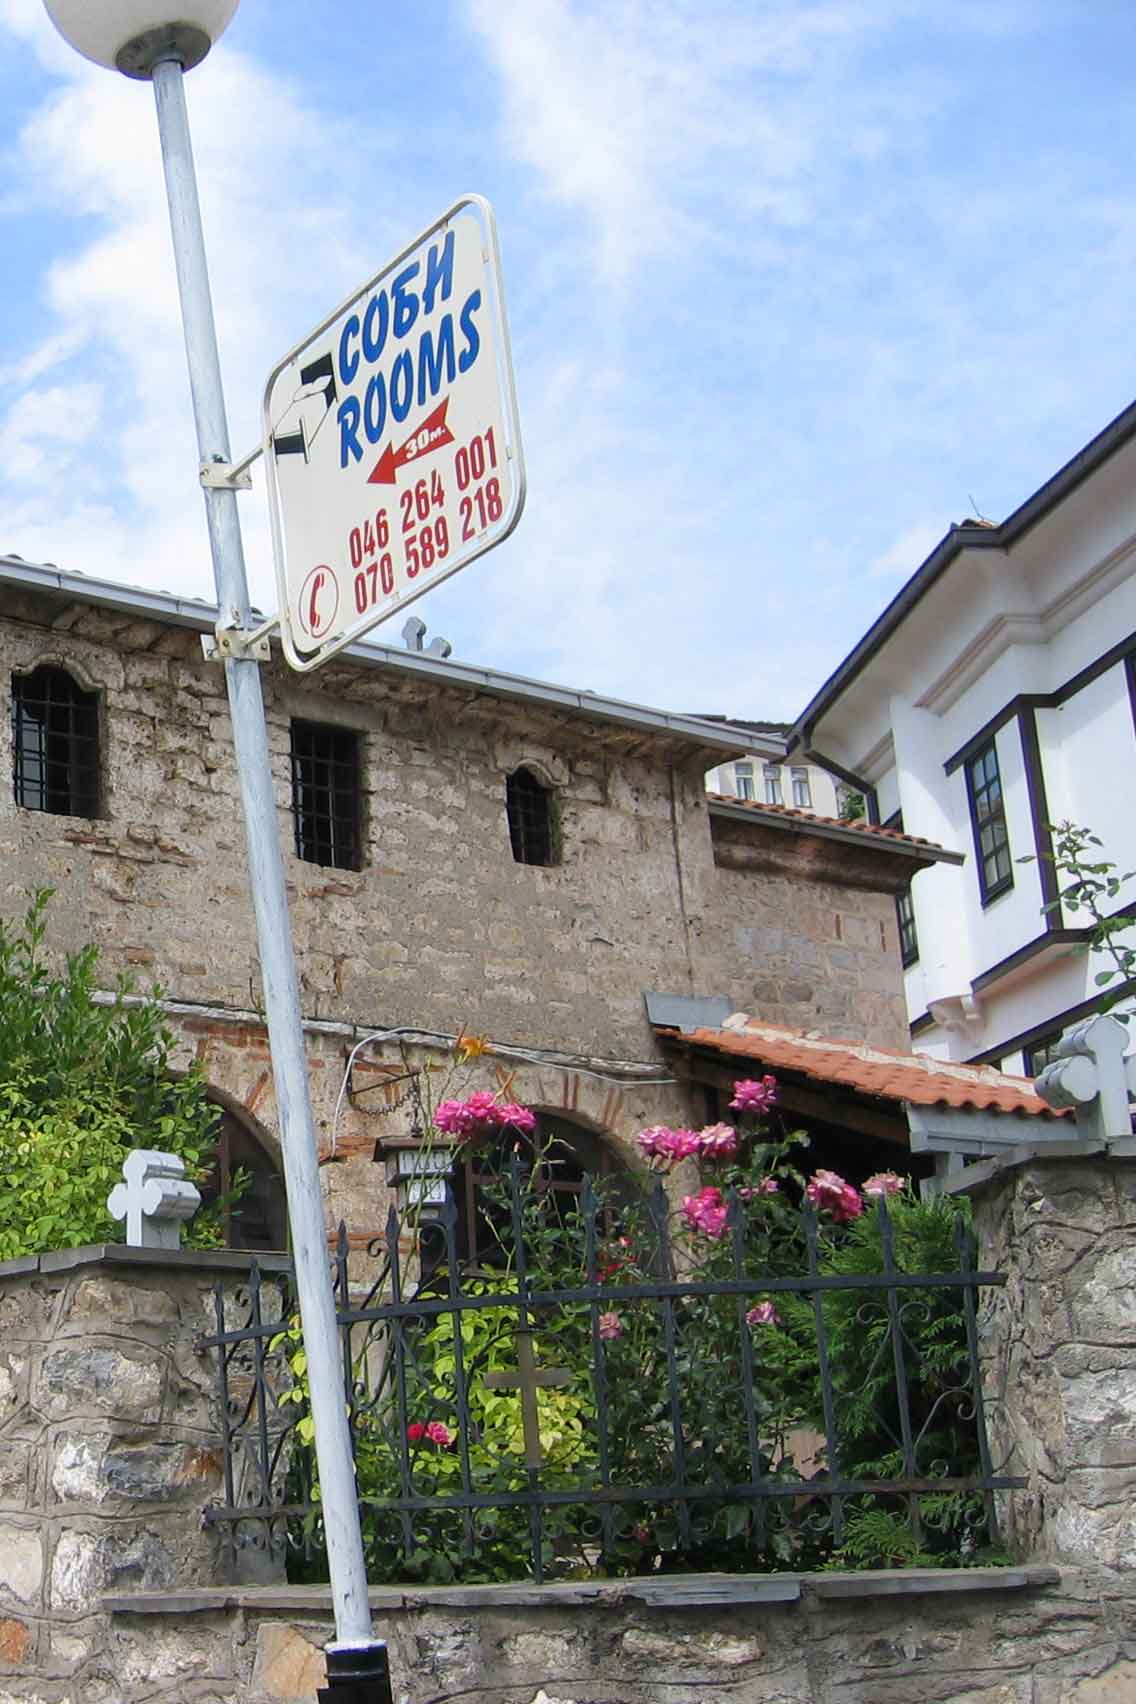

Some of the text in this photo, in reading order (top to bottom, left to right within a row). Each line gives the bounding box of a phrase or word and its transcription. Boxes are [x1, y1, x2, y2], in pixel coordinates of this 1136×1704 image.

[337, 289, 481, 469] ROOMS
[339, 230, 455, 385] СОБИ
[349, 426, 497, 568] 046 264 001
[354, 477, 503, 614] 070 589 218
